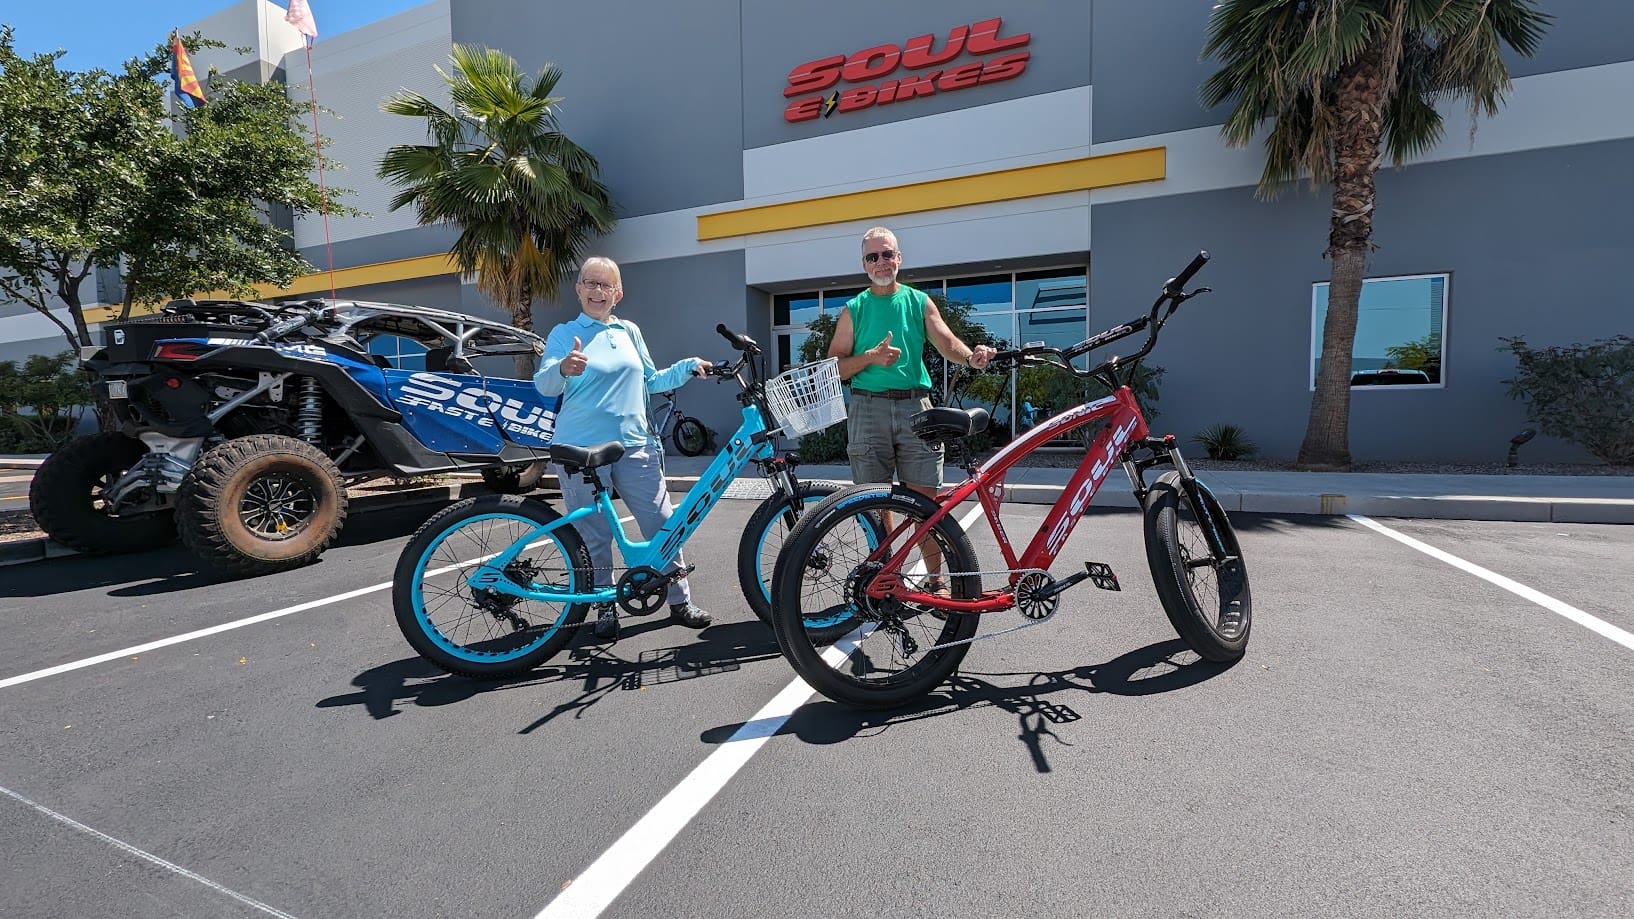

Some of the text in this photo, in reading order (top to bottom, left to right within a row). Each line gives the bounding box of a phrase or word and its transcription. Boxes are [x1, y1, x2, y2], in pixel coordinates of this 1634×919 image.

[783, 16, 1031, 98] SOUL
[395, 394, 479, 420] FAST
[507, 422, 553, 445] BIKE
[1046, 403, 1104, 430] SONIC
[660, 441, 754, 560] SOUL
[1046, 415, 1137, 556] SOUL
